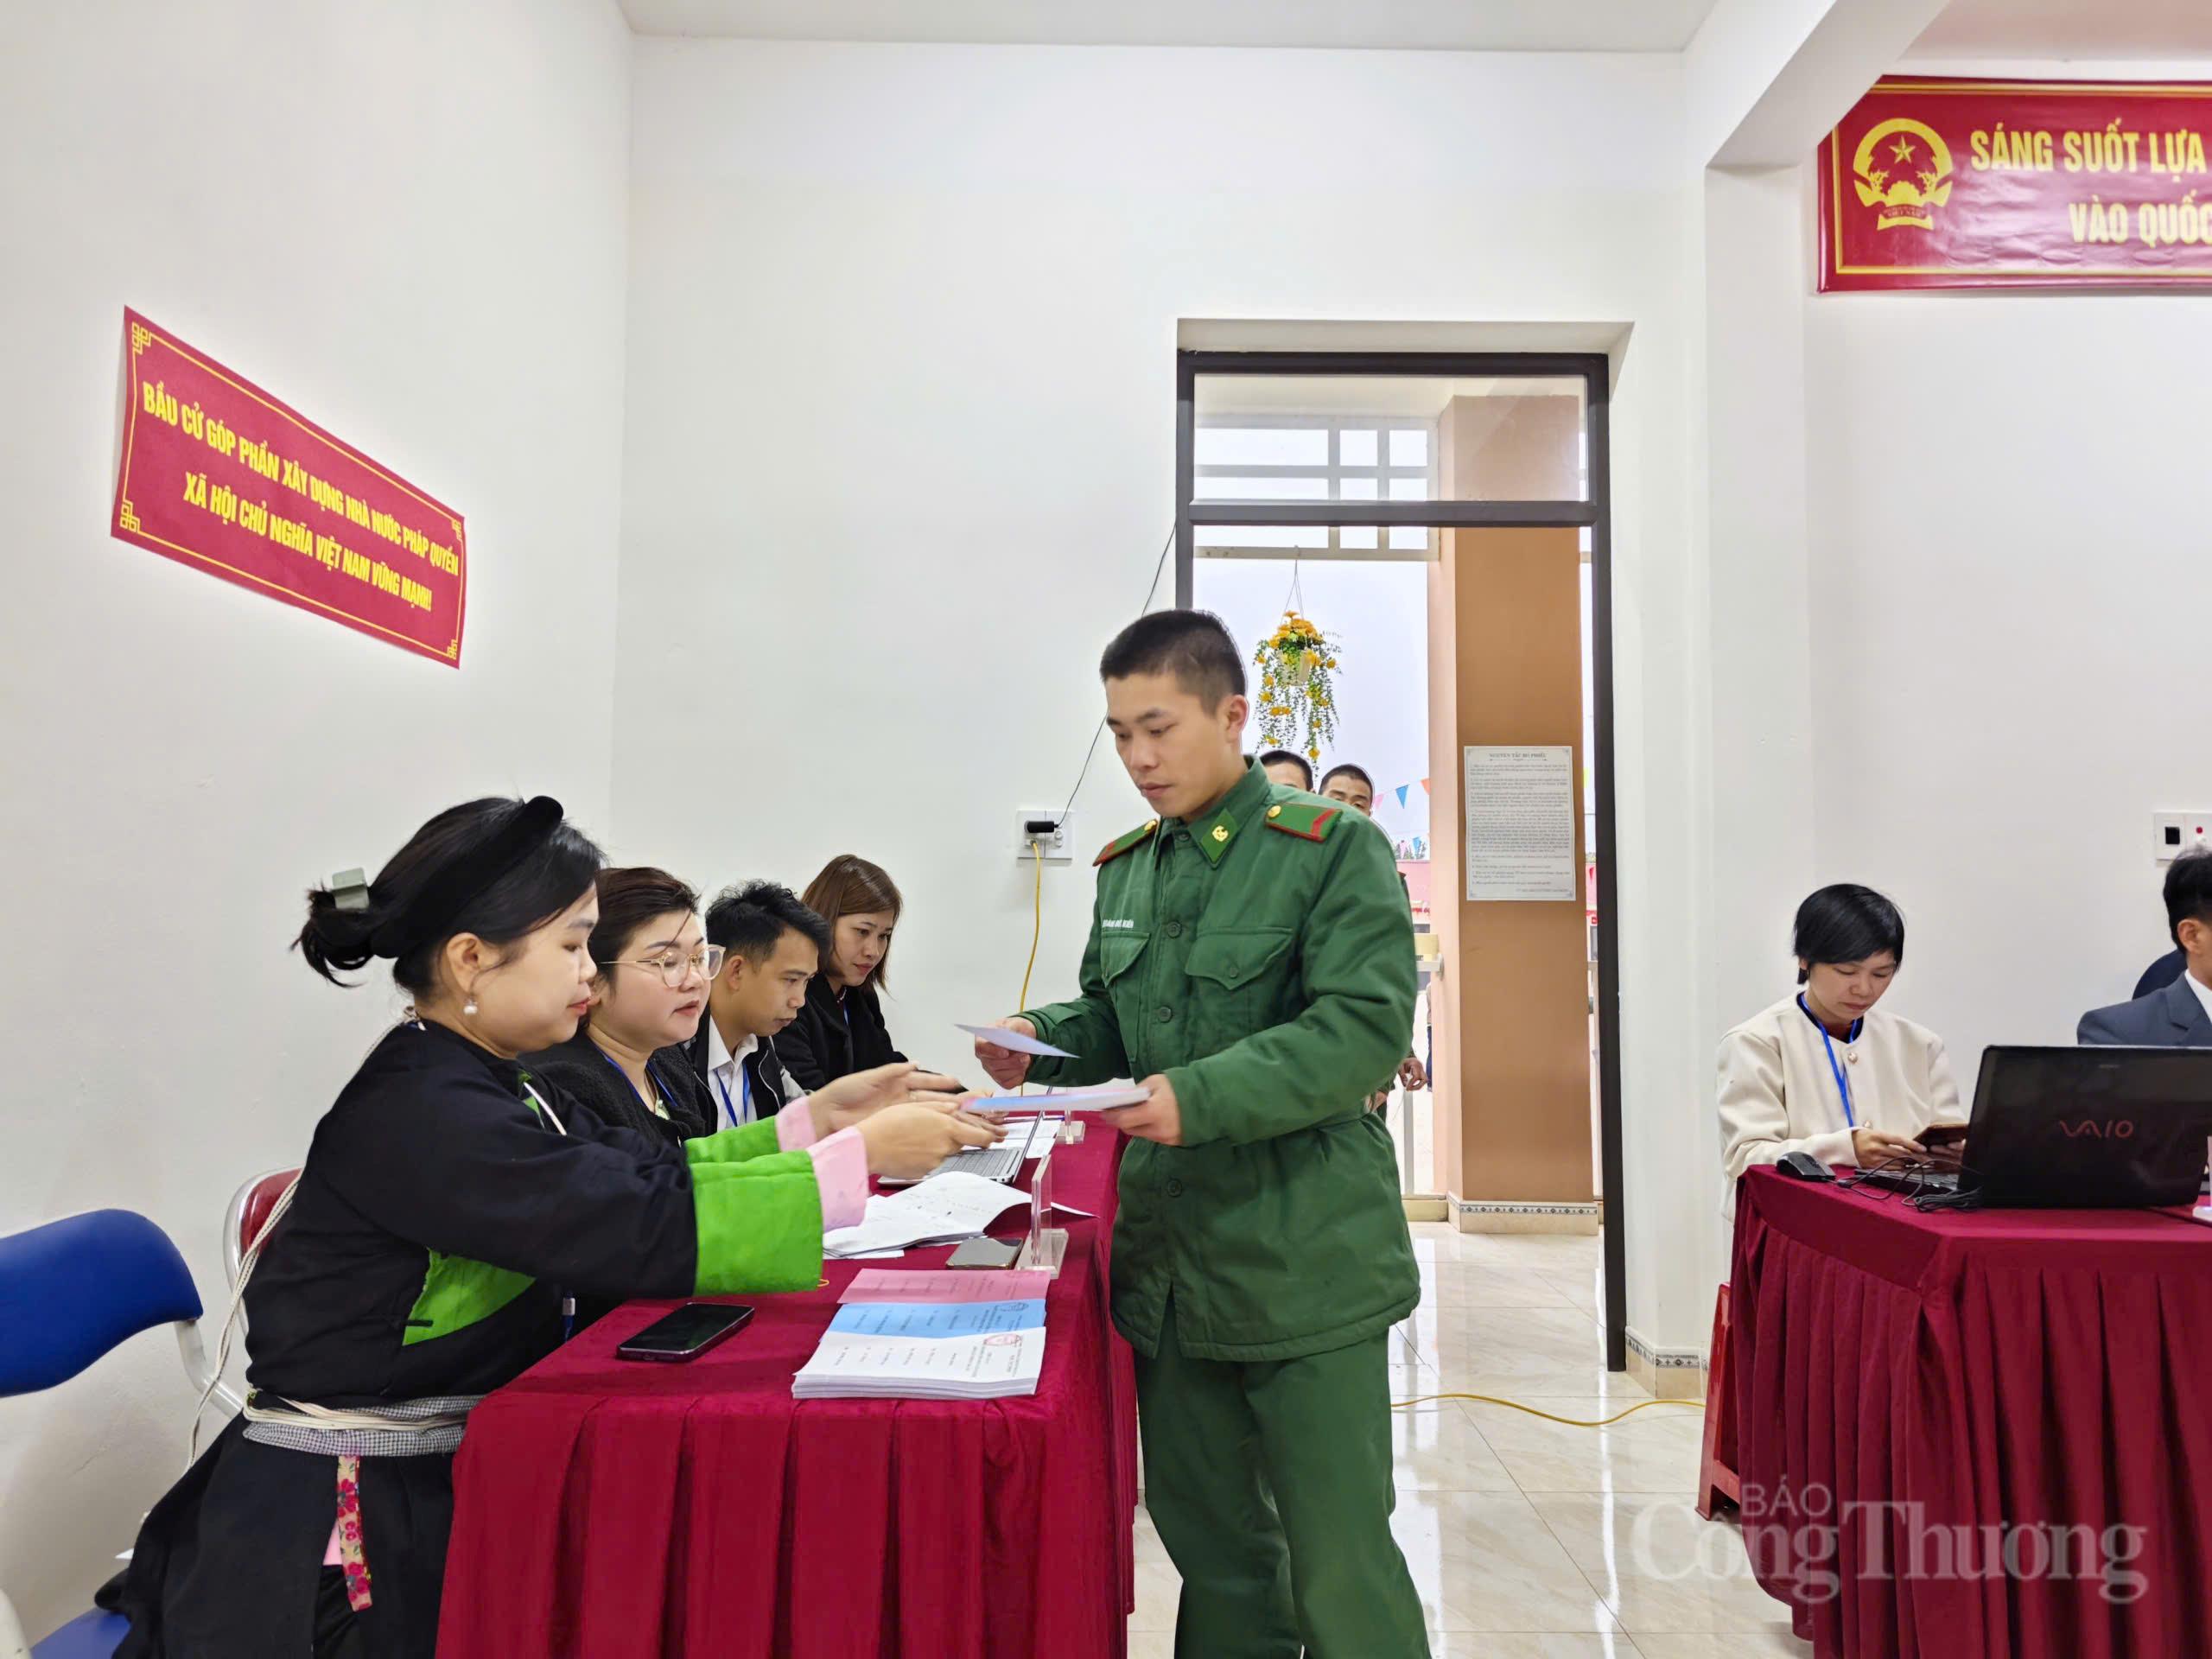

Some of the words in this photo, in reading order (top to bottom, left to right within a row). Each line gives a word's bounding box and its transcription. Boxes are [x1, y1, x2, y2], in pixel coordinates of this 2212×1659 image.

[1970, 122, 2054, 172] SÁNG
[2063, 118, 2139, 173] SUỐT
[2148, 128, 2208, 183] LỰA
[2069, 194, 2128, 243] VÀO
[143, 380, 178, 426] BẦU
[181, 402, 204, 440] CỬ
[206, 419, 236, 456] GÓP
[238, 435, 280, 482] PHẦN
[282, 460, 308, 496] XÂY
[309, 475, 344, 516] DỰNG
[346, 495, 370, 530] NHÀ
[371, 509, 401, 544] NƯỚC
[403, 525, 429, 558] PHÁP
[183, 472, 207, 509] XÃ
[210, 485, 237, 525] HỘI
[239, 500, 267, 537] CHỦ
[270, 516, 314, 557] NGHĨA
[315, 535, 343, 571] VIỆT
[342, 548, 371, 582] NAM
[372, 561, 401, 595] VỮNG
[2060, 1120, 2133, 1138] VAIO
